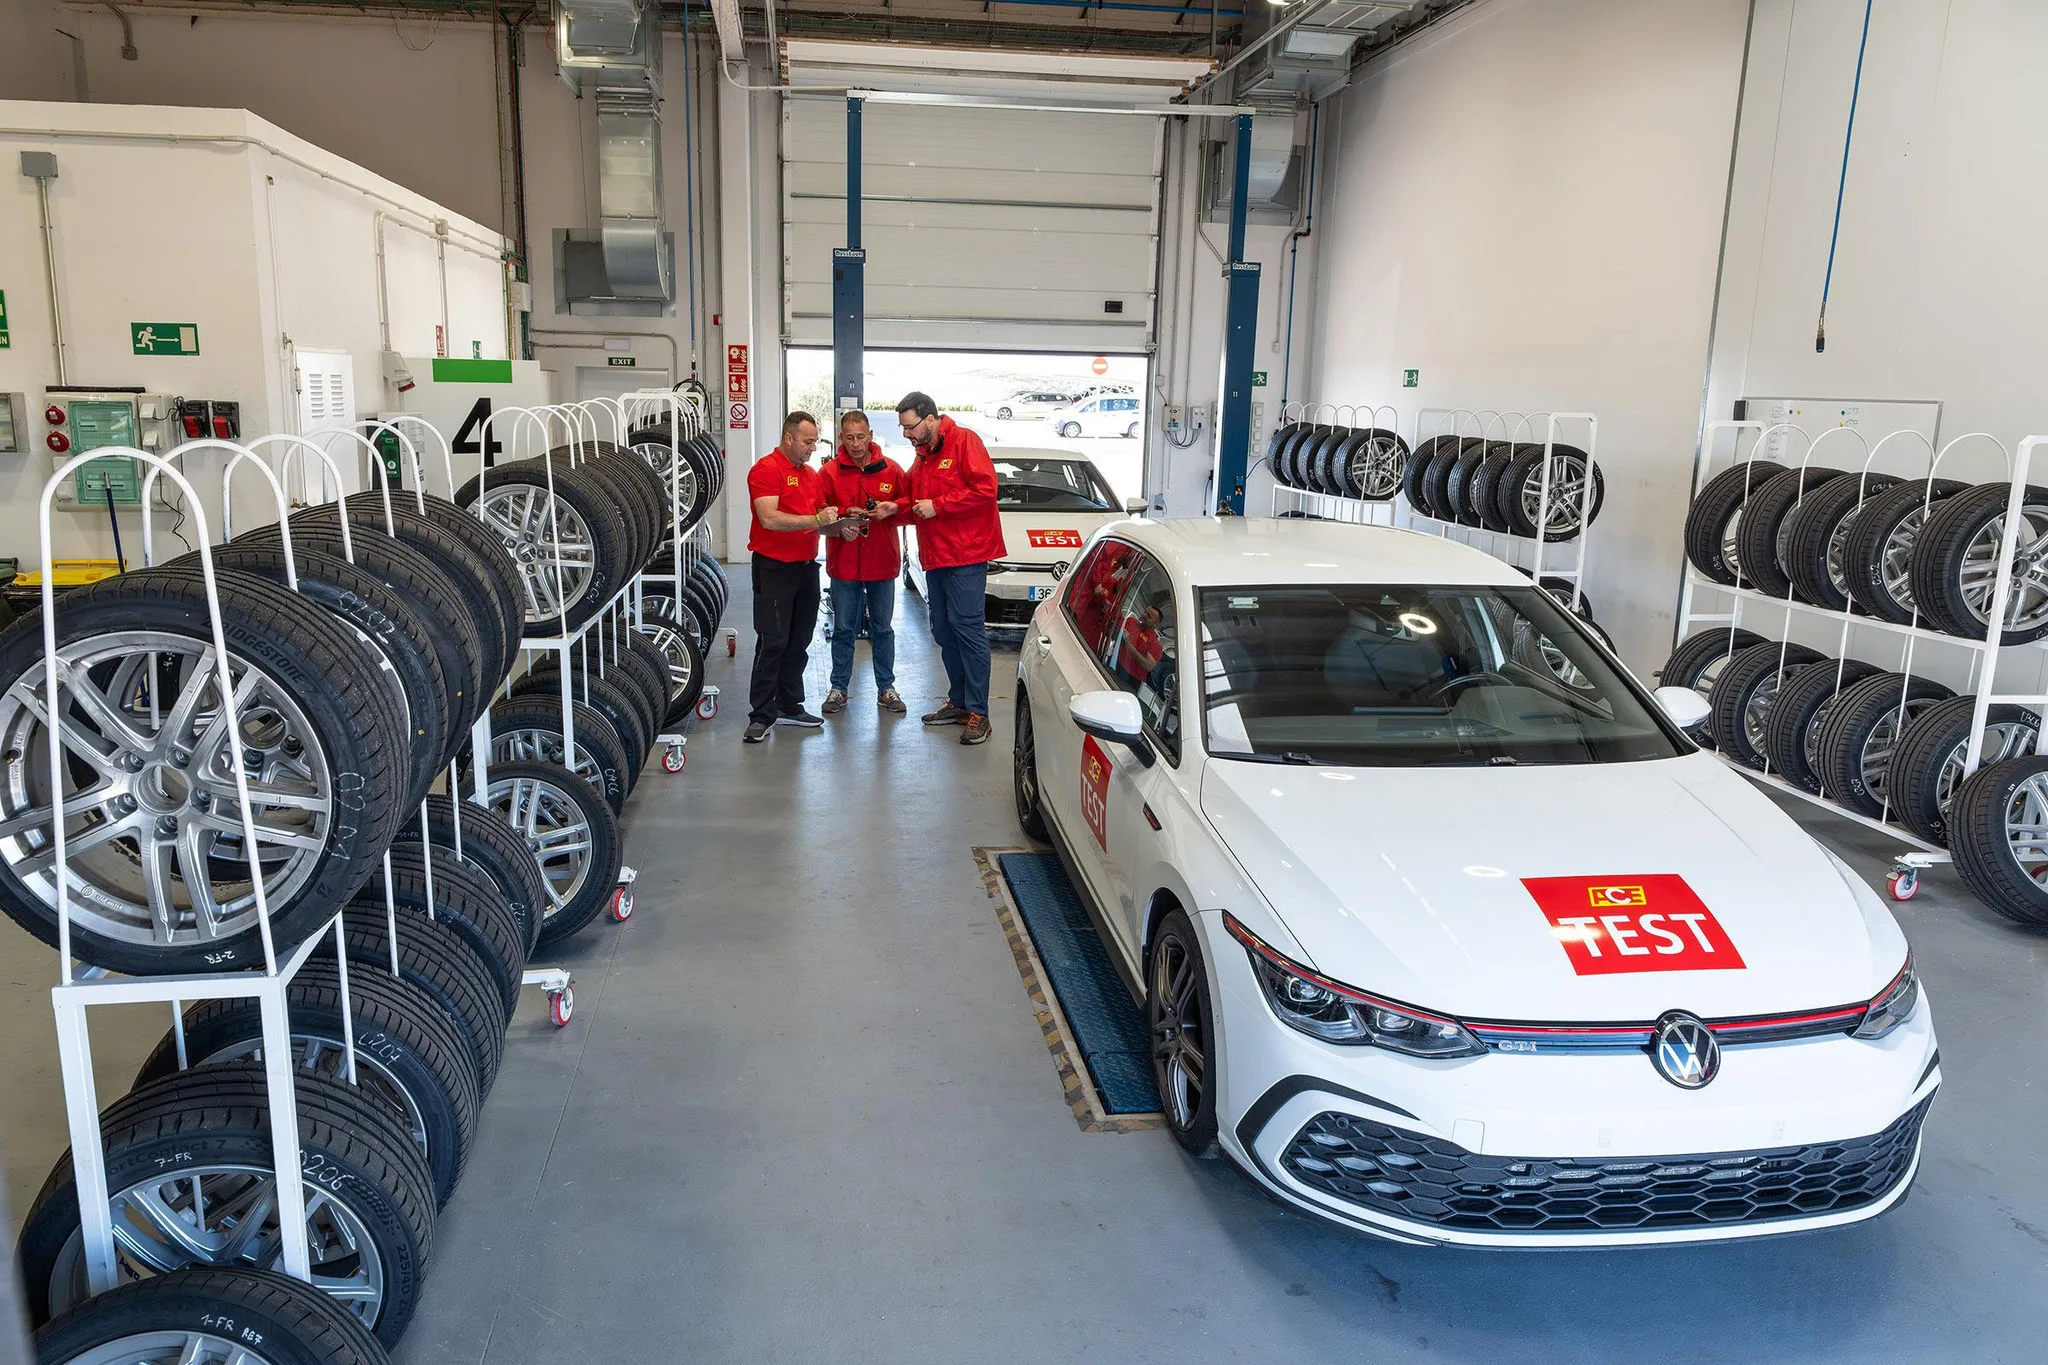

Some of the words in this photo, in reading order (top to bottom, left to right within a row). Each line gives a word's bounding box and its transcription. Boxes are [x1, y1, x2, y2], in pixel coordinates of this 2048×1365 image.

[452, 397, 503, 467] 4
[1032, 536, 1078, 545] TEST
[1082, 772, 1105, 836] TEST
[1591, 886, 1646, 906] ACE
[1556, 913, 1716, 958] TEST
[203, 950, 236, 965] 2-FR
[1498, 1040, 1537, 1052] GTI
[154, 1151, 193, 1168] 7-FR
[200, 1313, 234, 1332] 1-FR
